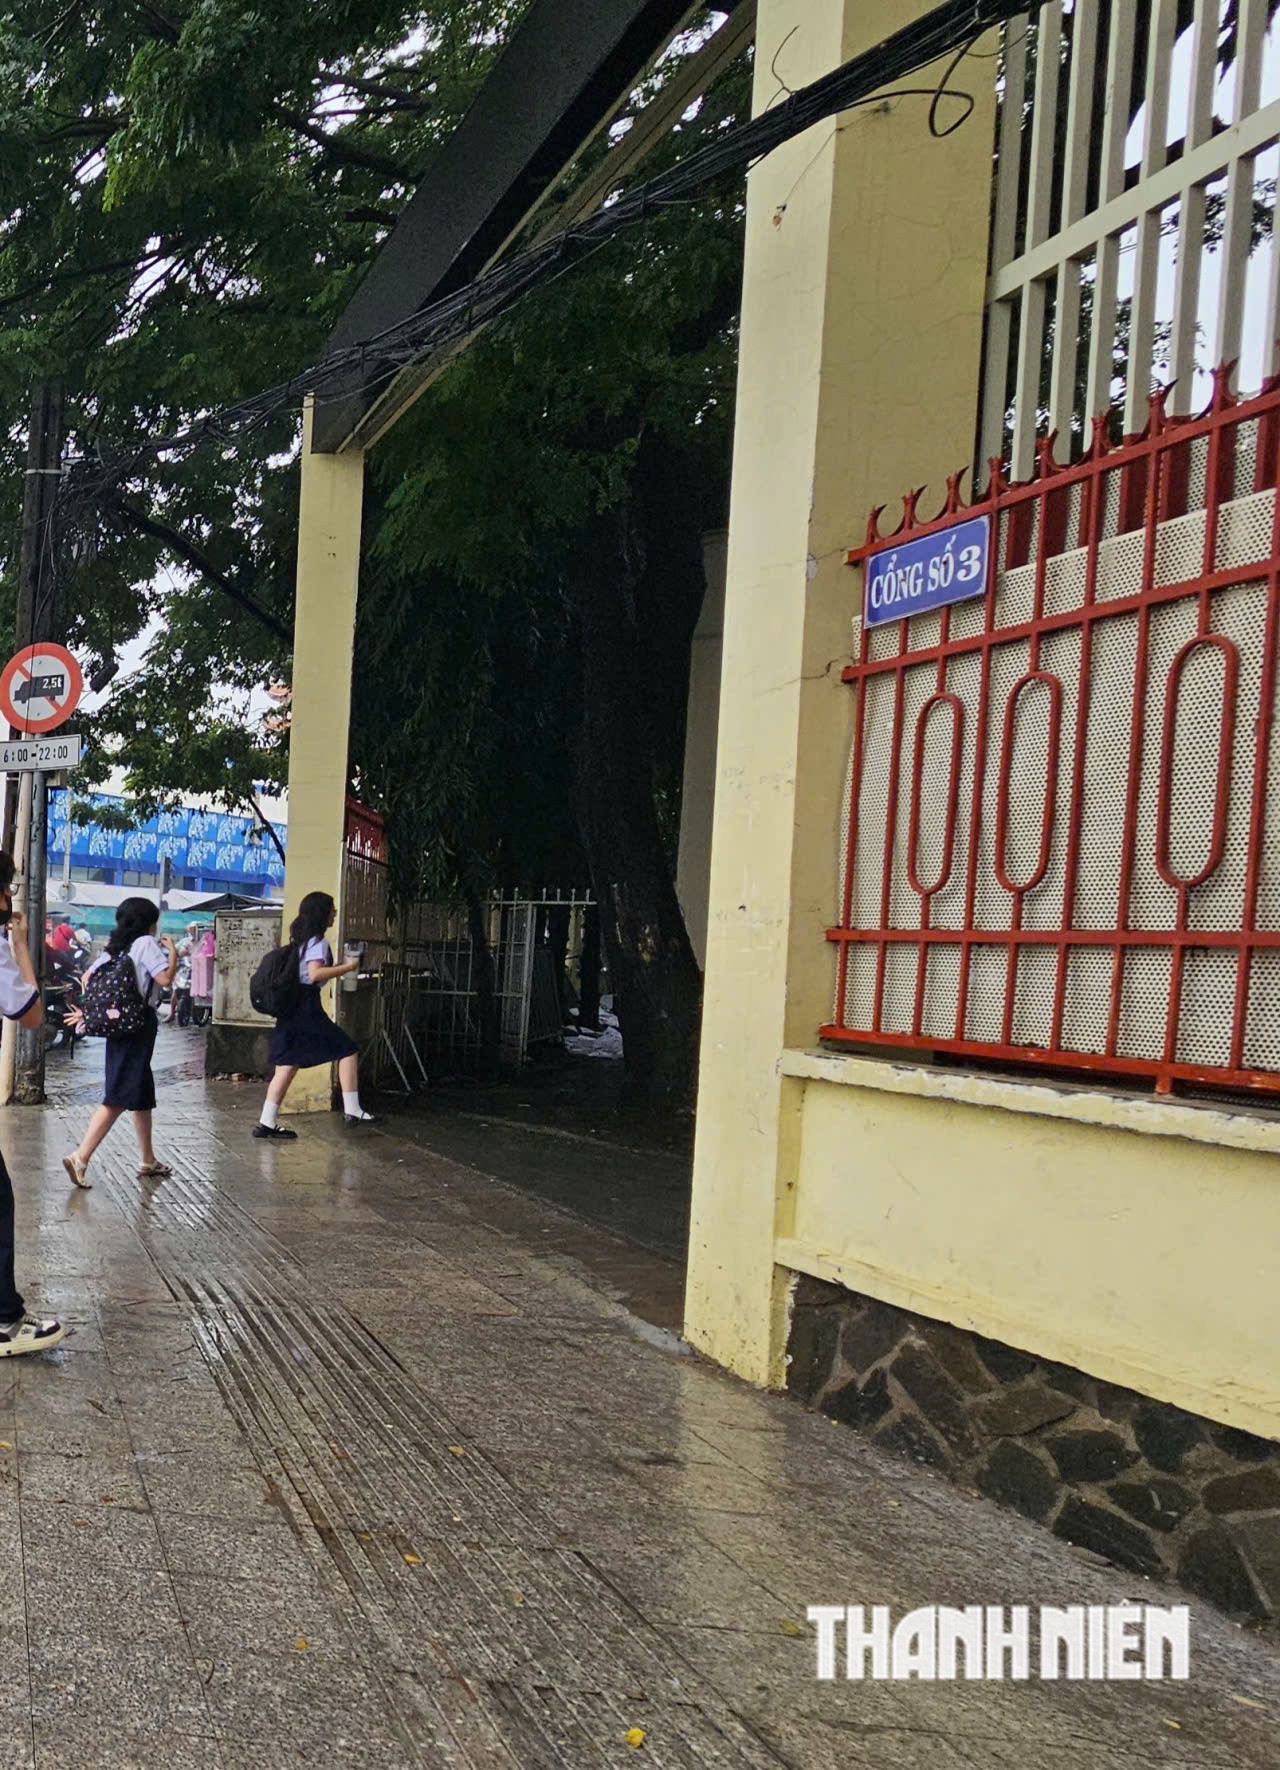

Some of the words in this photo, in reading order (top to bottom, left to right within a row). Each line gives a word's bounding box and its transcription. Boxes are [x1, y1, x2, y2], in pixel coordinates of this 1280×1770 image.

[871, 553, 923, 608] CỔNG
[927, 534, 956, 592] SỐ
[957, 545, 981, 581] 3
